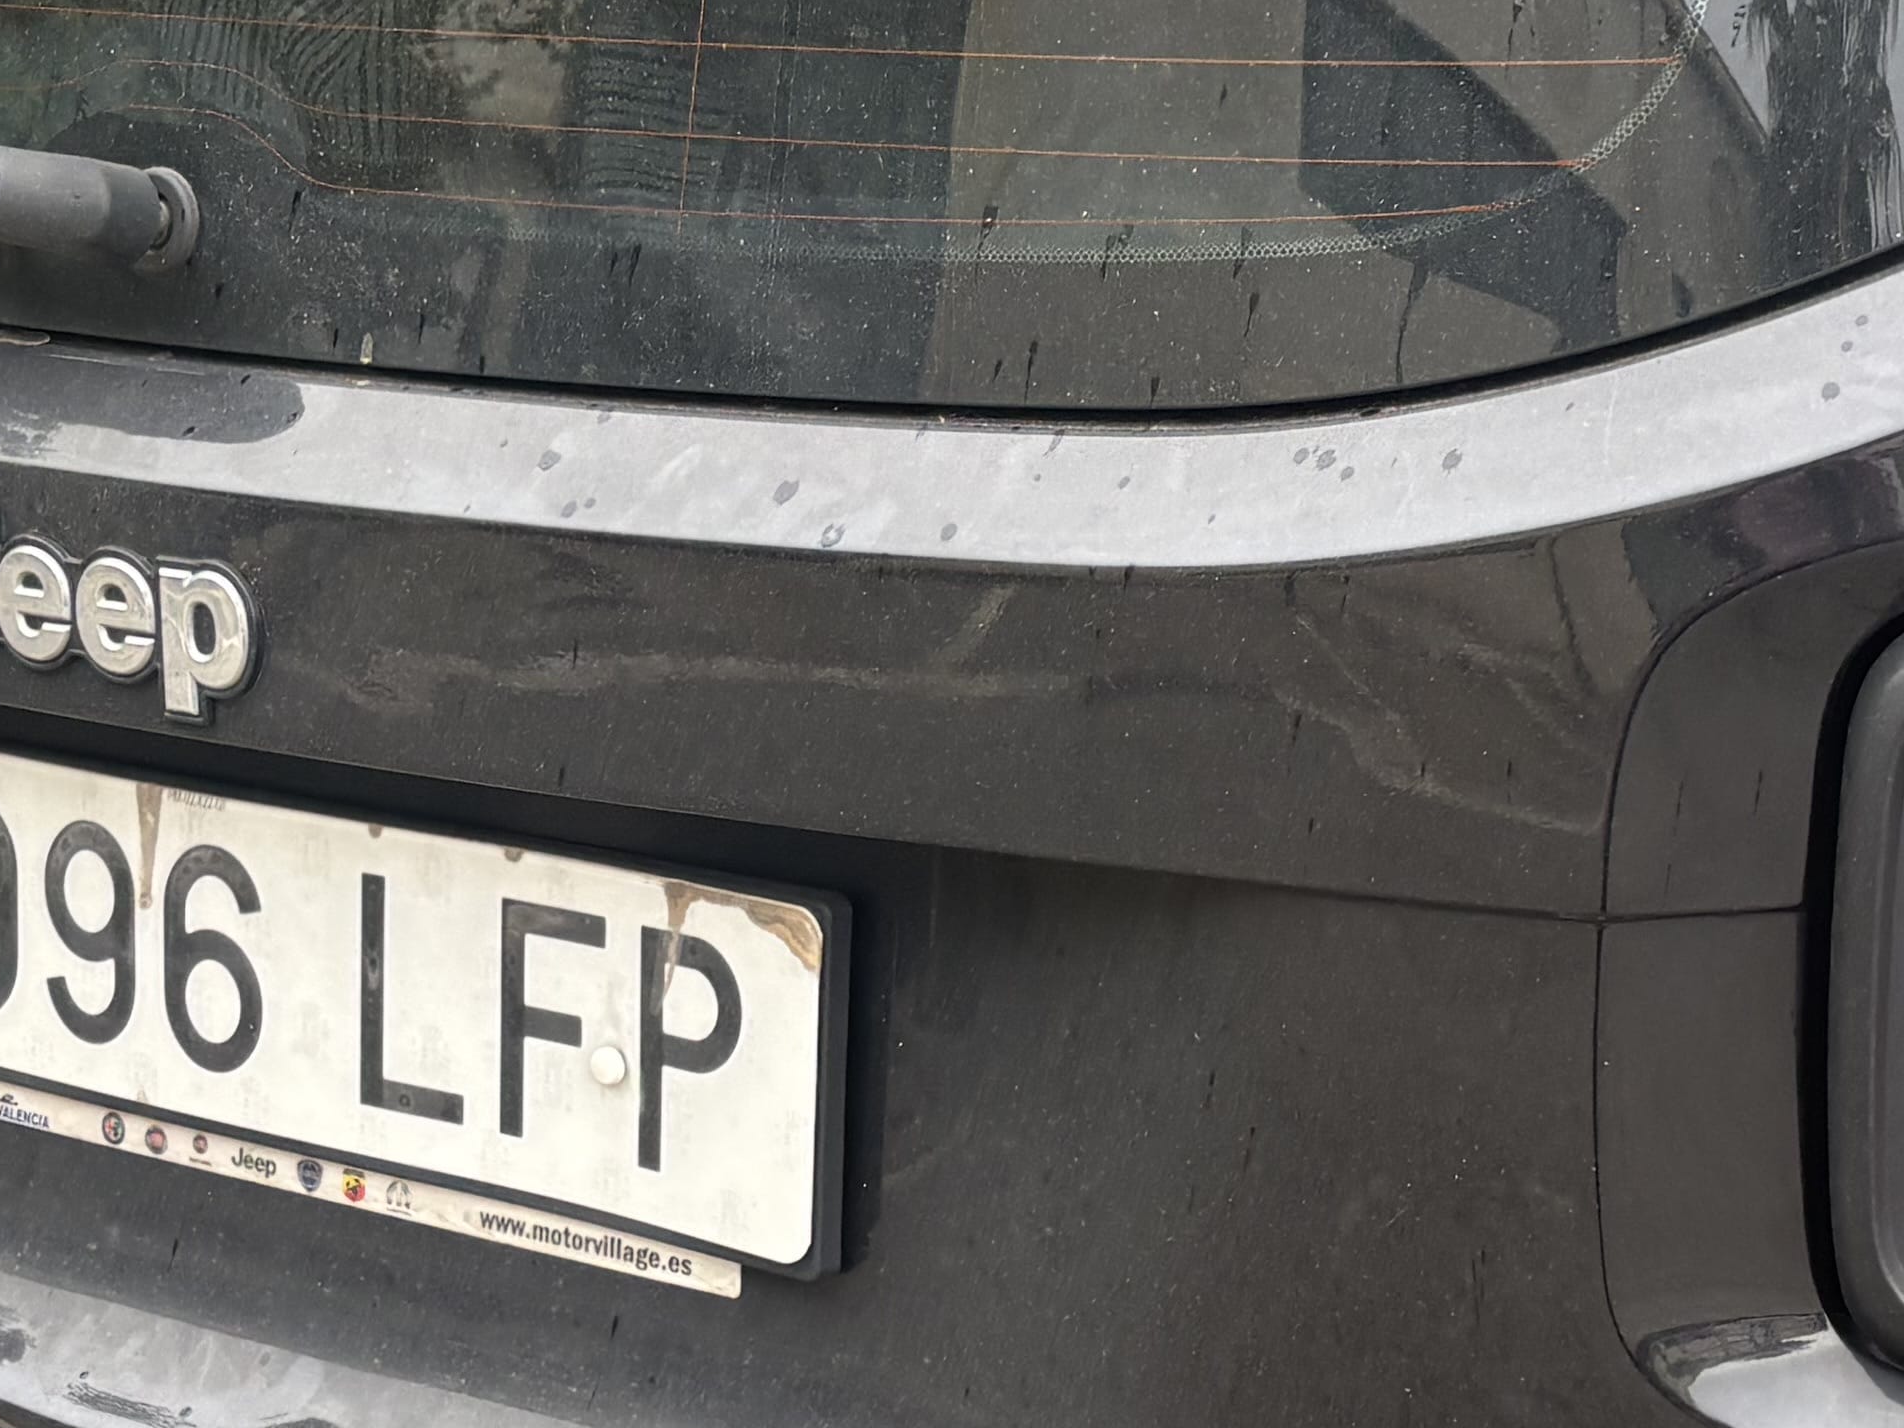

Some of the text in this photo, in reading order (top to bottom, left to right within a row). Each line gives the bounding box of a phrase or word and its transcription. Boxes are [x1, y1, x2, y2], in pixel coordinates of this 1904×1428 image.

[359, 872, 744, 1173] LFP
[231, 1146, 277, 1178] Jeep
[479, 1210, 693, 1276] www.motorvillage.es
